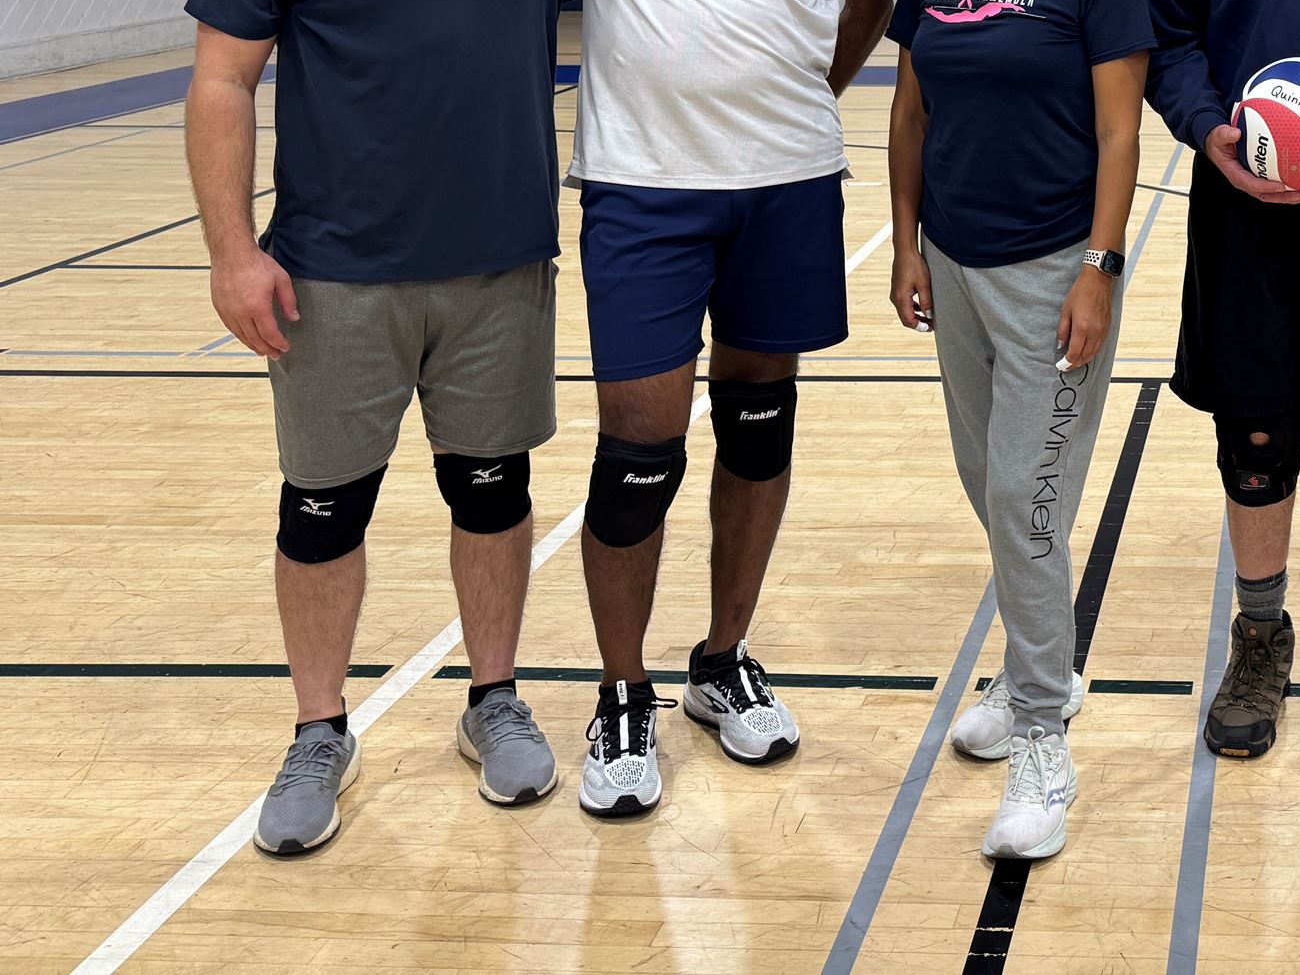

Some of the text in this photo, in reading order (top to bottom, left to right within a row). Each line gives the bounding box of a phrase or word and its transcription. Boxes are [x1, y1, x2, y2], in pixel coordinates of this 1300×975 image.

[739, 408, 778, 421] Franklin
[1029, 363, 1088, 560] Calvin Klein
[623, 473, 667, 484] Franklin
